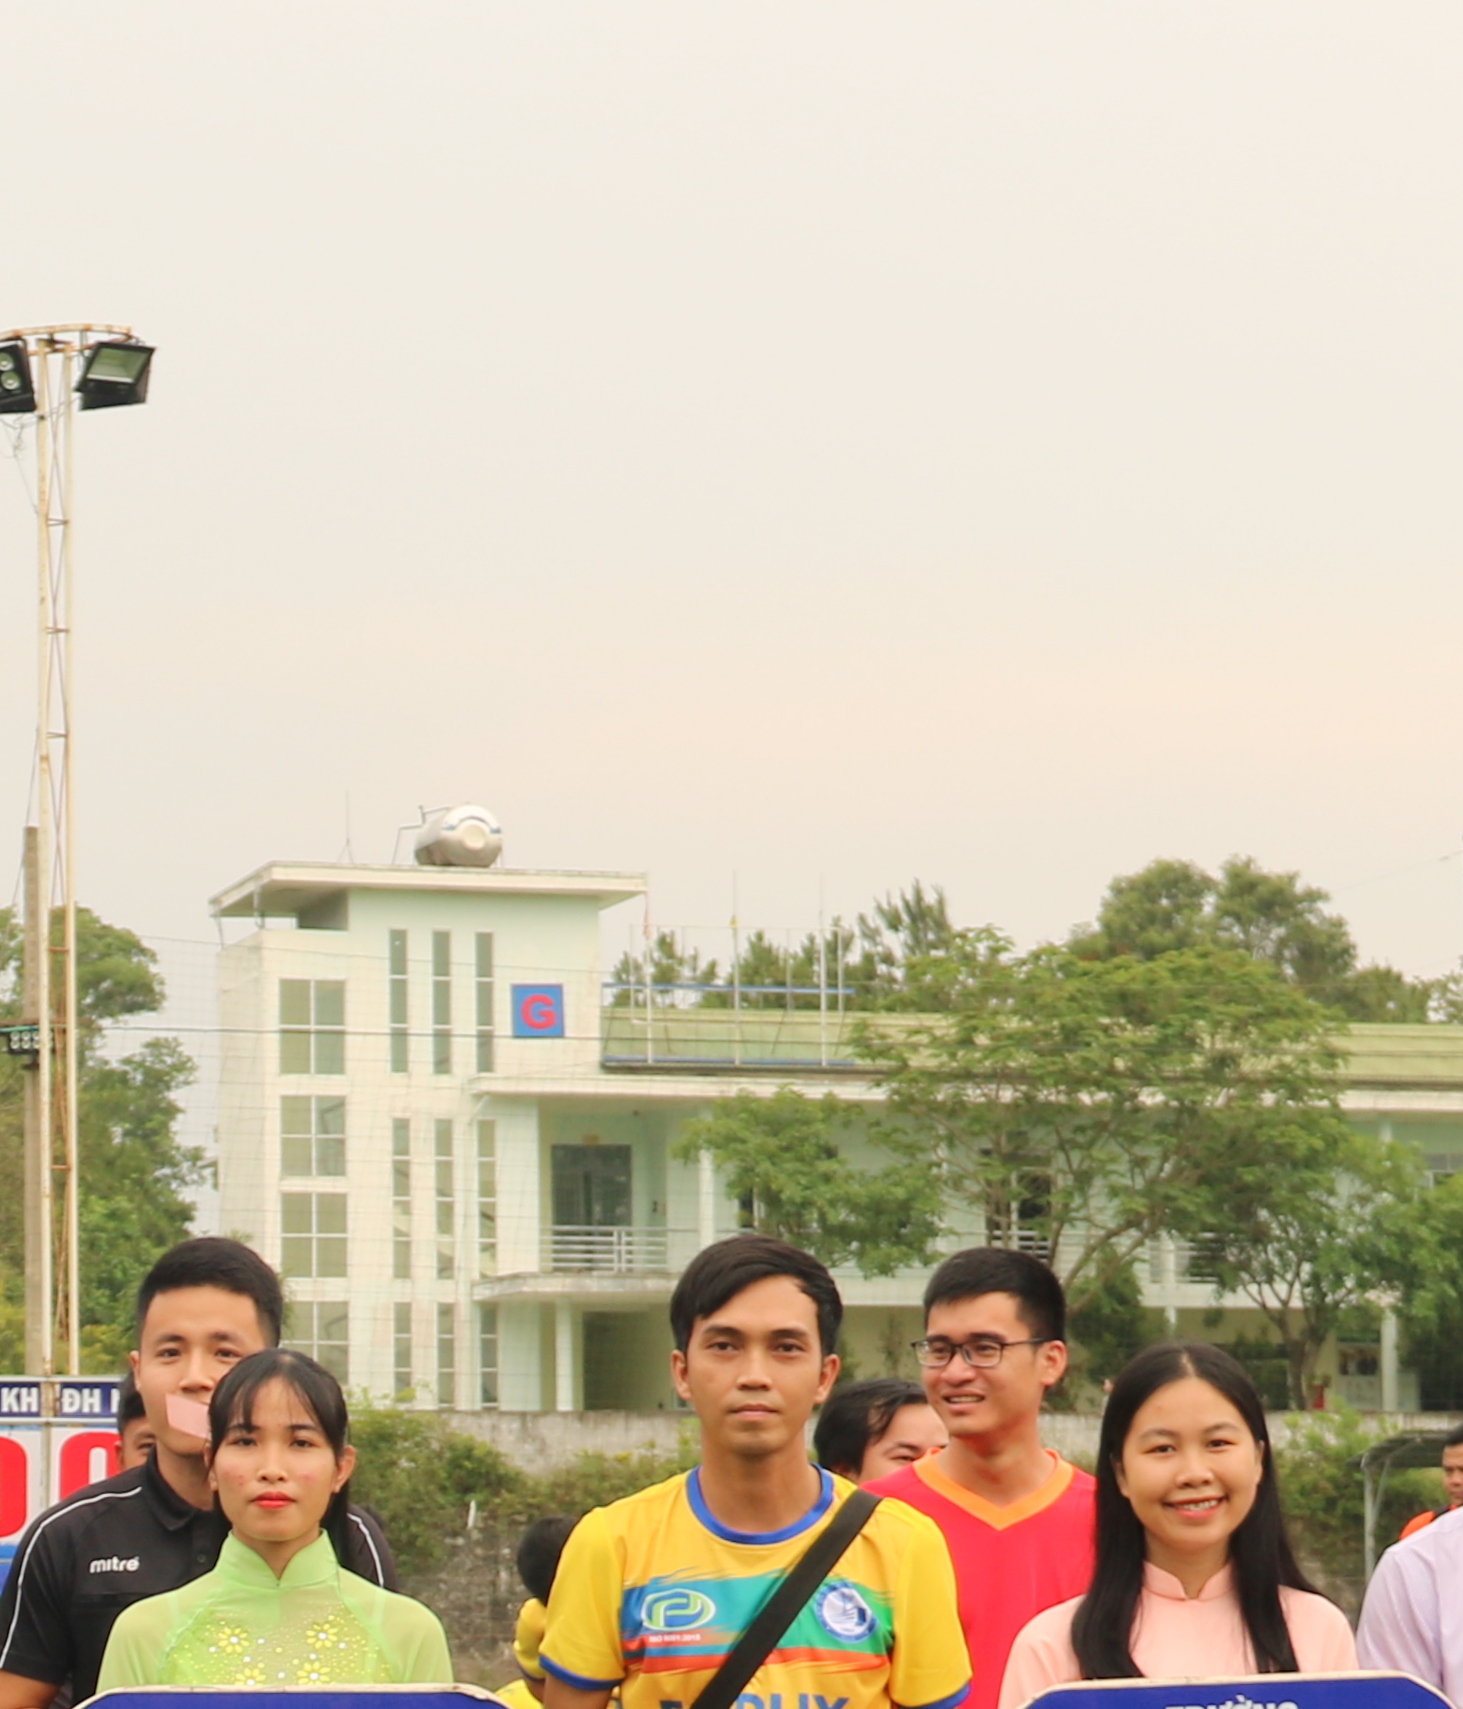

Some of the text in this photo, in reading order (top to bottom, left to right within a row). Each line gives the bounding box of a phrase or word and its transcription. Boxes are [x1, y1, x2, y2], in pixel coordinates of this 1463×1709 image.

[521, 994, 556, 1029] G
[1, 1386, 38, 1412] KH
[62, 1389, 100, 1412] ĐH
[90, 1556, 139, 1573] mitre
